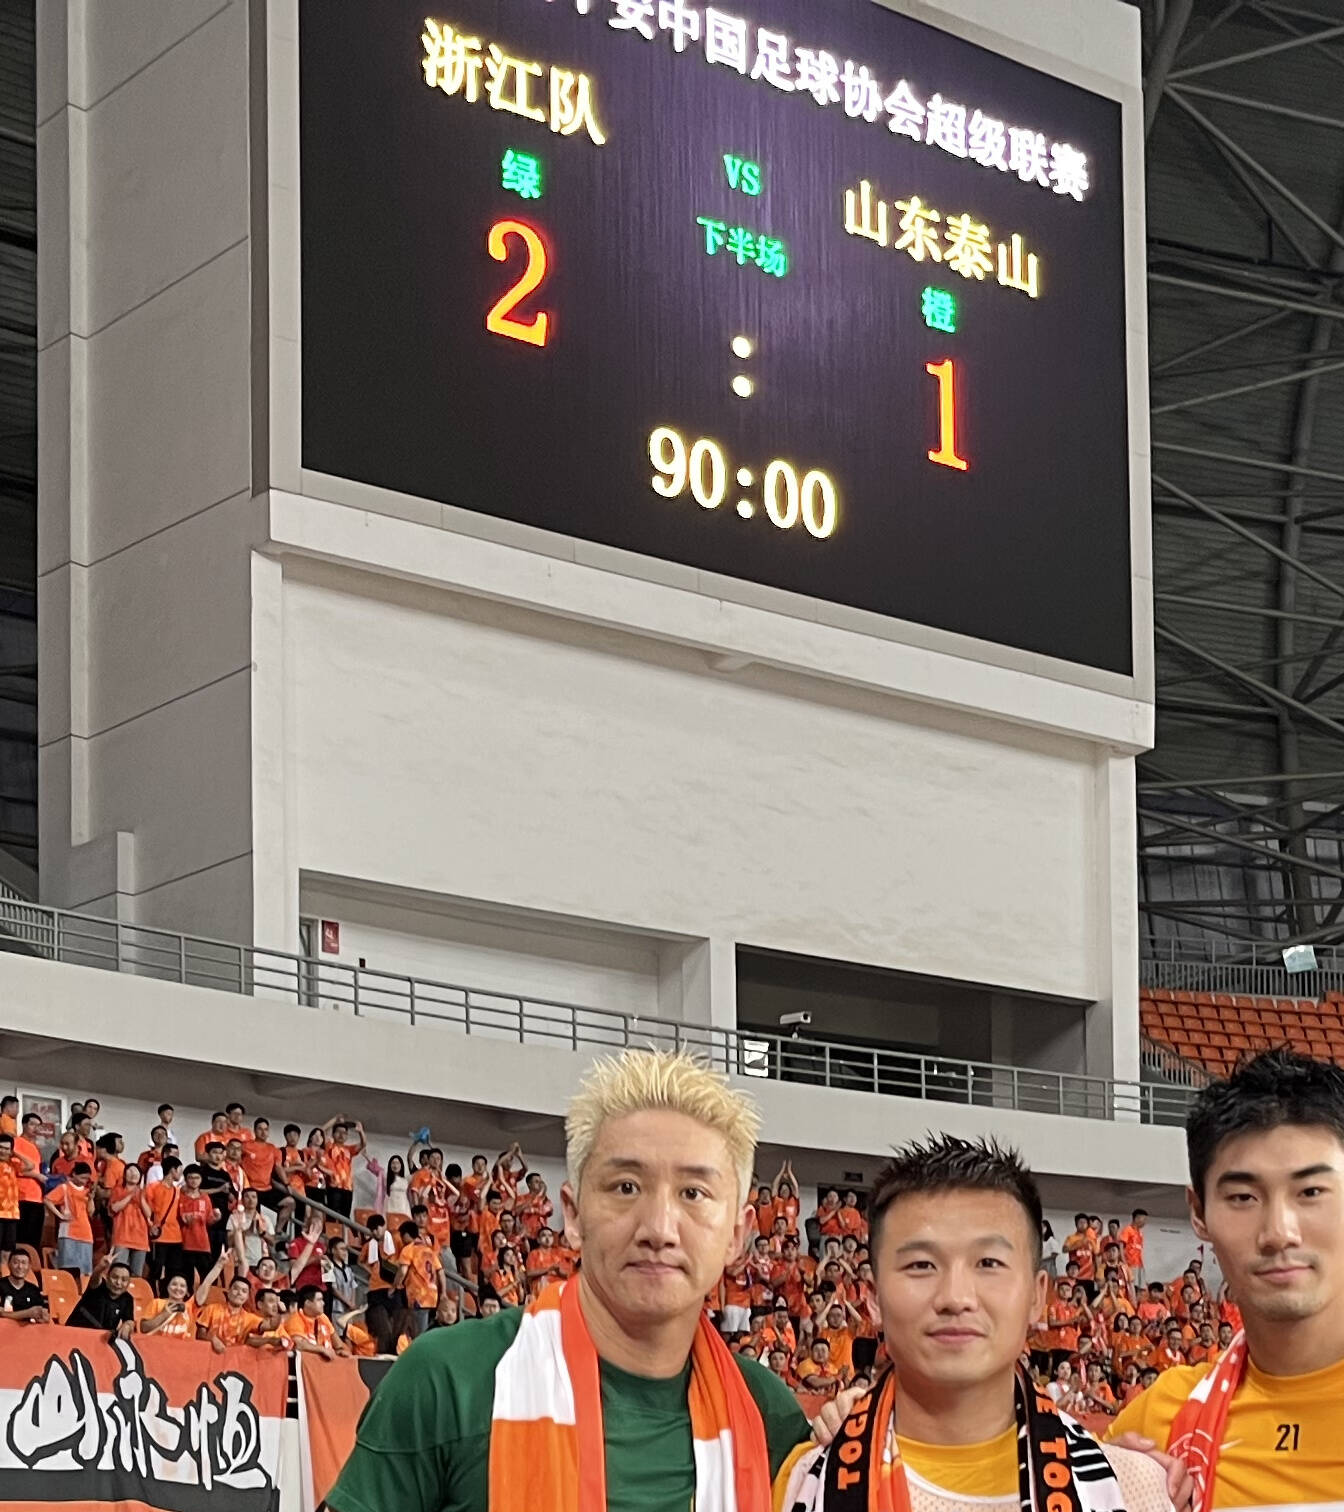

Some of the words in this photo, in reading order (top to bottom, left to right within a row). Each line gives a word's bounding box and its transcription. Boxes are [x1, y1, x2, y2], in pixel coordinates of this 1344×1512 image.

[421, 17, 606, 146] 浙江队
[574, 0, 1089, 201] 安中国足球协会超级联赛
[502, 150, 541, 198] 绿
[723, 154, 761, 196] VS
[486, 219, 548, 347] 2
[696, 216, 787, 277] 下半场
[845, 180, 1039, 298] 山东泰山
[925, 359, 969, 471] 1
[649, 427, 837, 539] 90:00
[1275, 1423, 1300, 1452] 21
